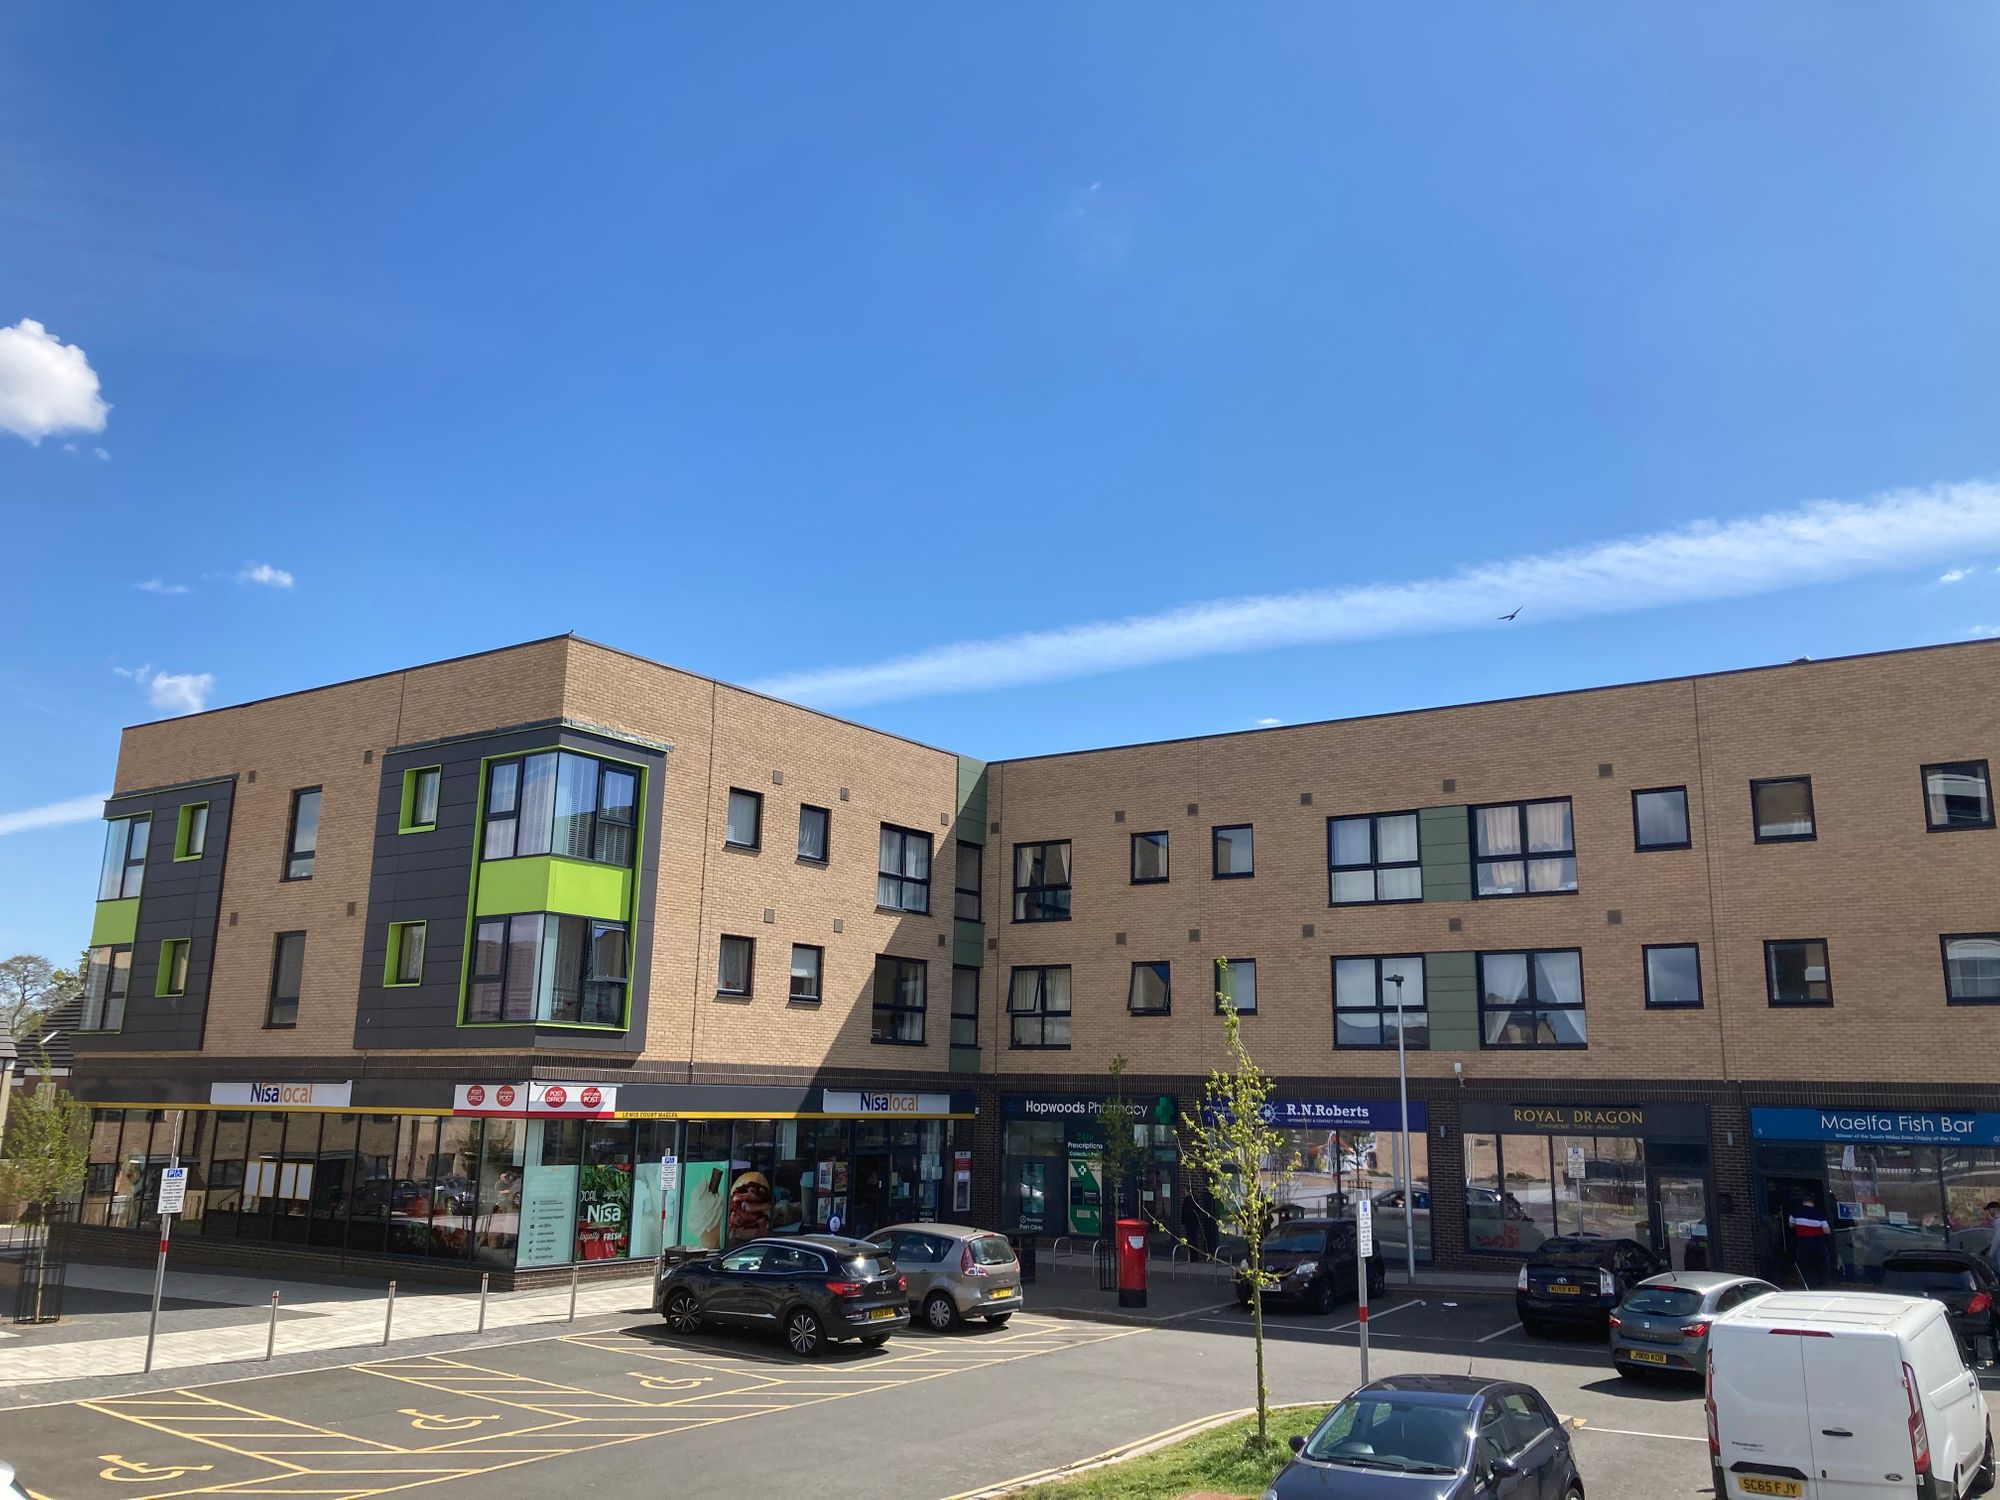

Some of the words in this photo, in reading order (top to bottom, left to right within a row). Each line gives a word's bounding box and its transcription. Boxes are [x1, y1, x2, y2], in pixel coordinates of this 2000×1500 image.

[583, 1096, 599, 1104] POST
[1025, 1100, 1086, 1115] Hopwoods
[1514, 1109, 1564, 1122] ROYAL
[1573, 1110, 1644, 1124] DRAGON
[1821, 1114, 1892, 1131] Maelfa
[1898, 1115, 1934, 1132] Fish
[1940, 1116, 1976, 1133] Bar
[1067, 1141, 1104, 1150] Prescriptions
[587, 1203, 621, 1223] Nisa
[603, 1232, 622, 1241] FRESH
[1743, 1479, 1772, 1492] SC65
